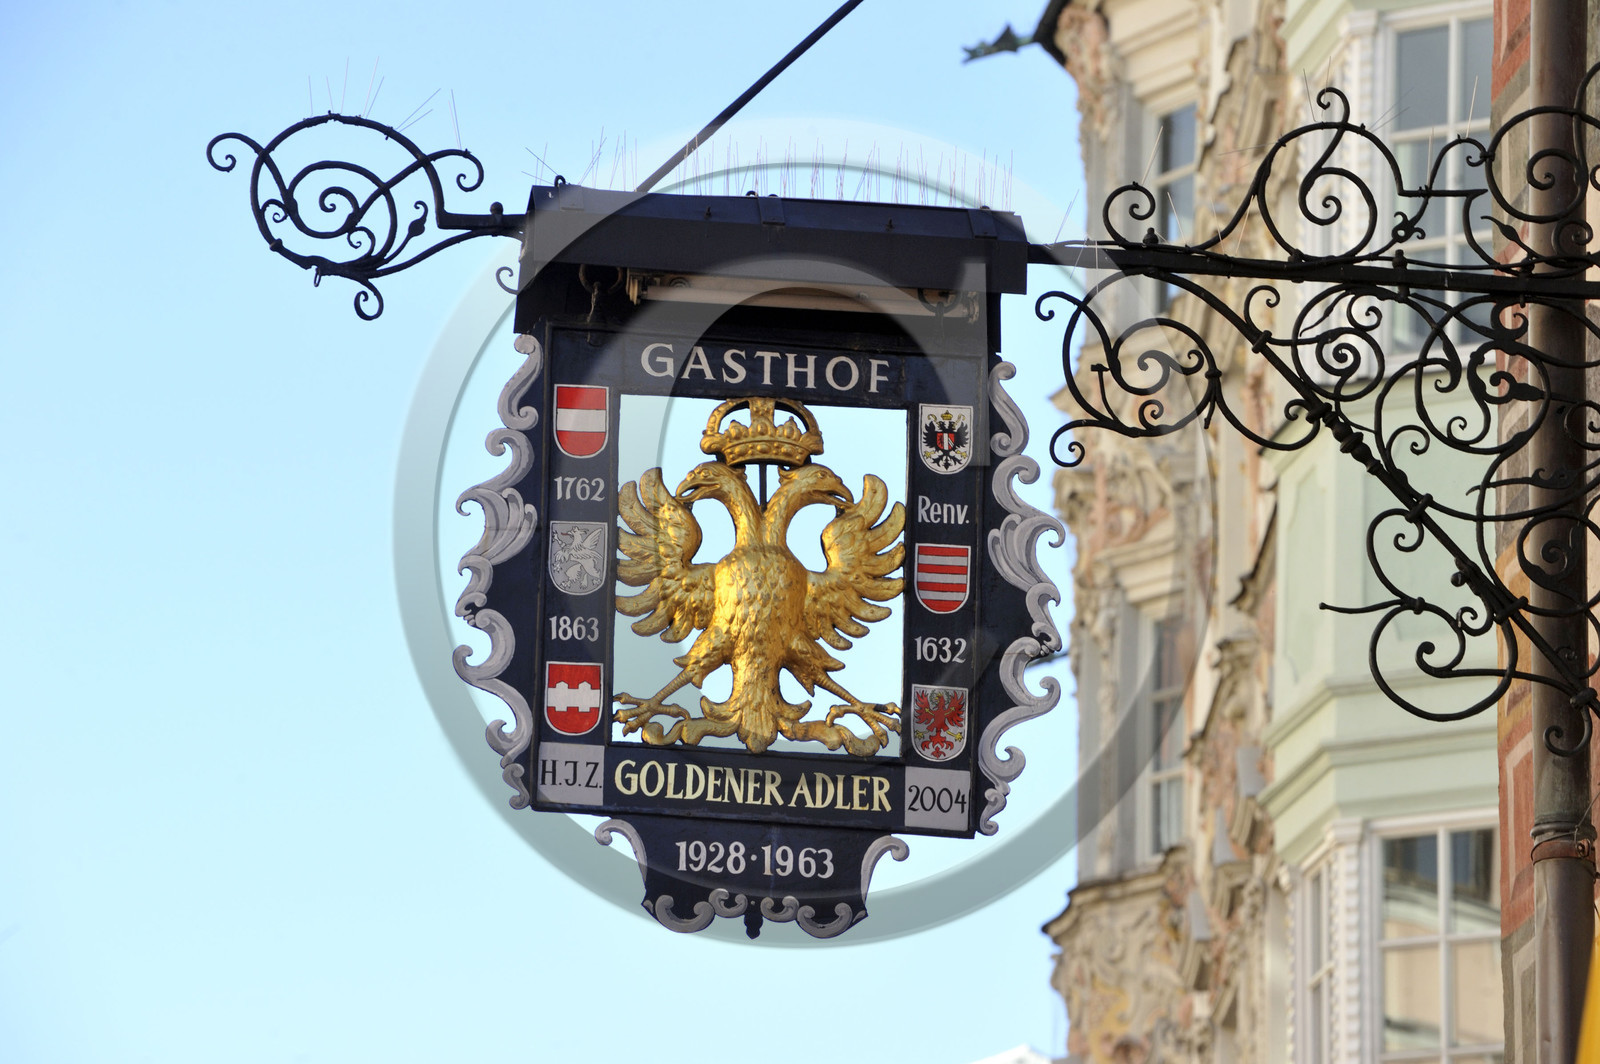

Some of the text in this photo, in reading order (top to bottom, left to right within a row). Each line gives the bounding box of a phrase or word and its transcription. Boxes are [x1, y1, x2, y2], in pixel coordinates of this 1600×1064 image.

[641, 343, 889, 393] GASTHOF
[554, 476, 605, 502] 1762
[916, 495, 970, 524] Renv.
[549, 615, 599, 643] 1863
[915, 637, 966, 664] 1632
[614, 759, 892, 812] GOLDENER ADLER
[908, 786, 967, 813] 2004
